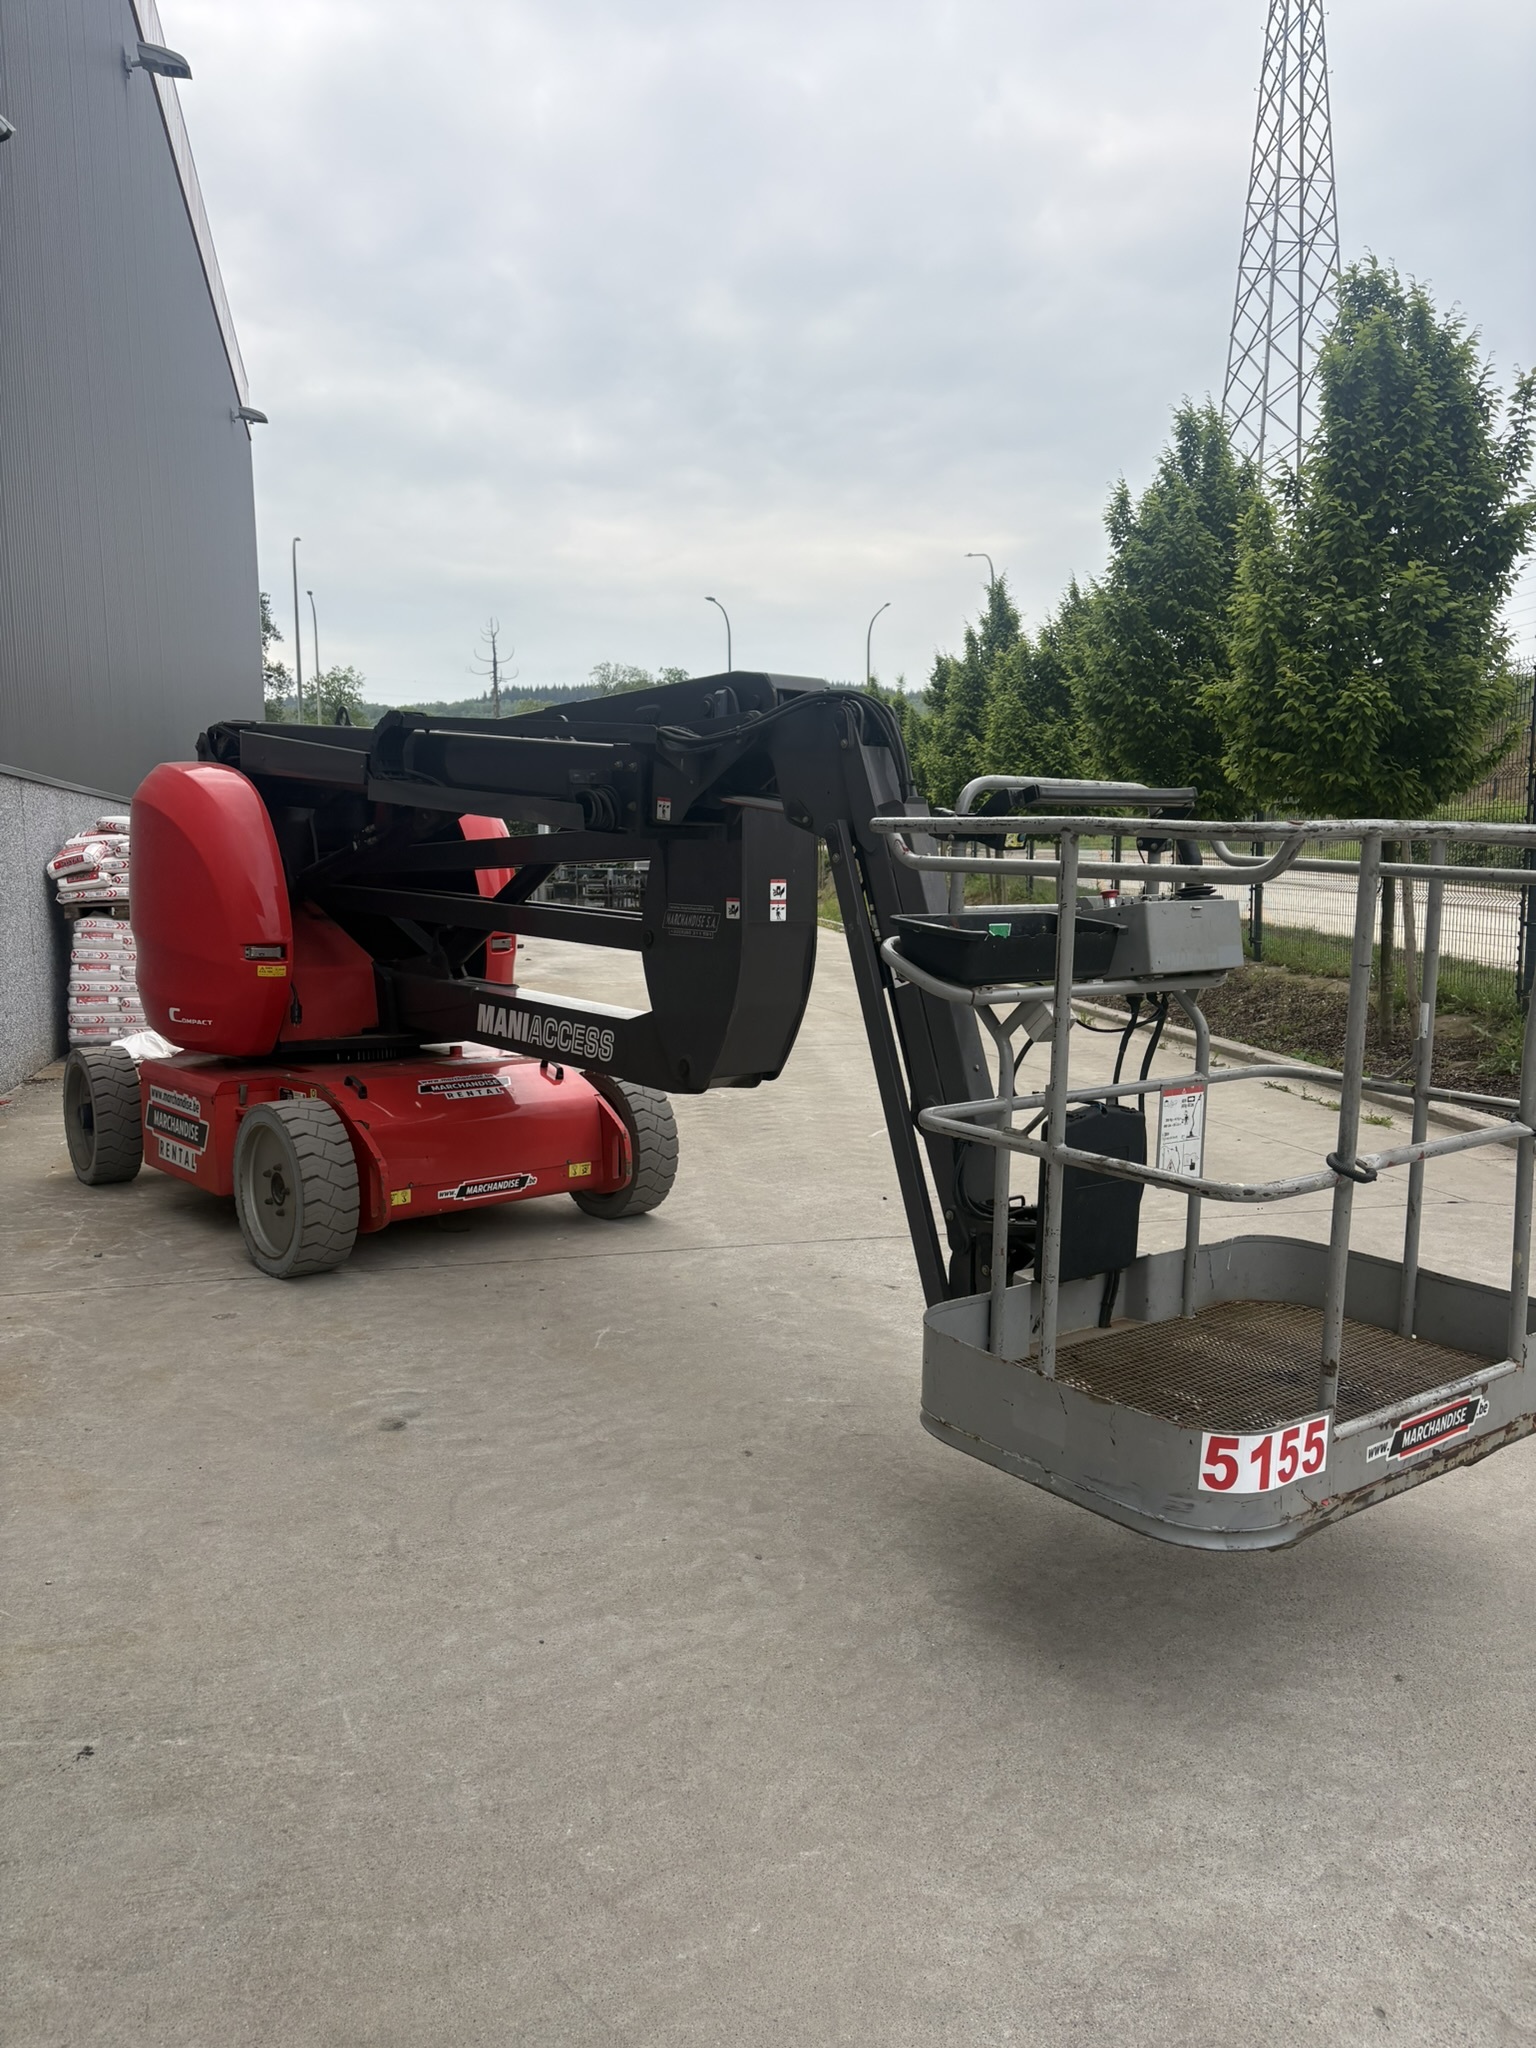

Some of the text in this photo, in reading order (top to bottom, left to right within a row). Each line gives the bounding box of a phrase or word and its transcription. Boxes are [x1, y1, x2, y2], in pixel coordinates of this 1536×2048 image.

[666, 913, 705, 928] MARCHANDISE
[476, 1003, 615, 1062] MANIACCESS
[431, 1080, 500, 1092] MARCHANDISE
[447, 1087, 502, 1099] RENTAL
[151, 1088, 200, 1114] www.marchandise.be
[153, 1109, 199, 1142] MARCHANDISE
[160, 1140, 196, 1169] RENTAL
[465, 1178, 520, 1196] MARCHANDISE
[1401, 1406, 1468, 1449] MARCHANDISE
[1202, 1418, 1326, 1491] 5155
